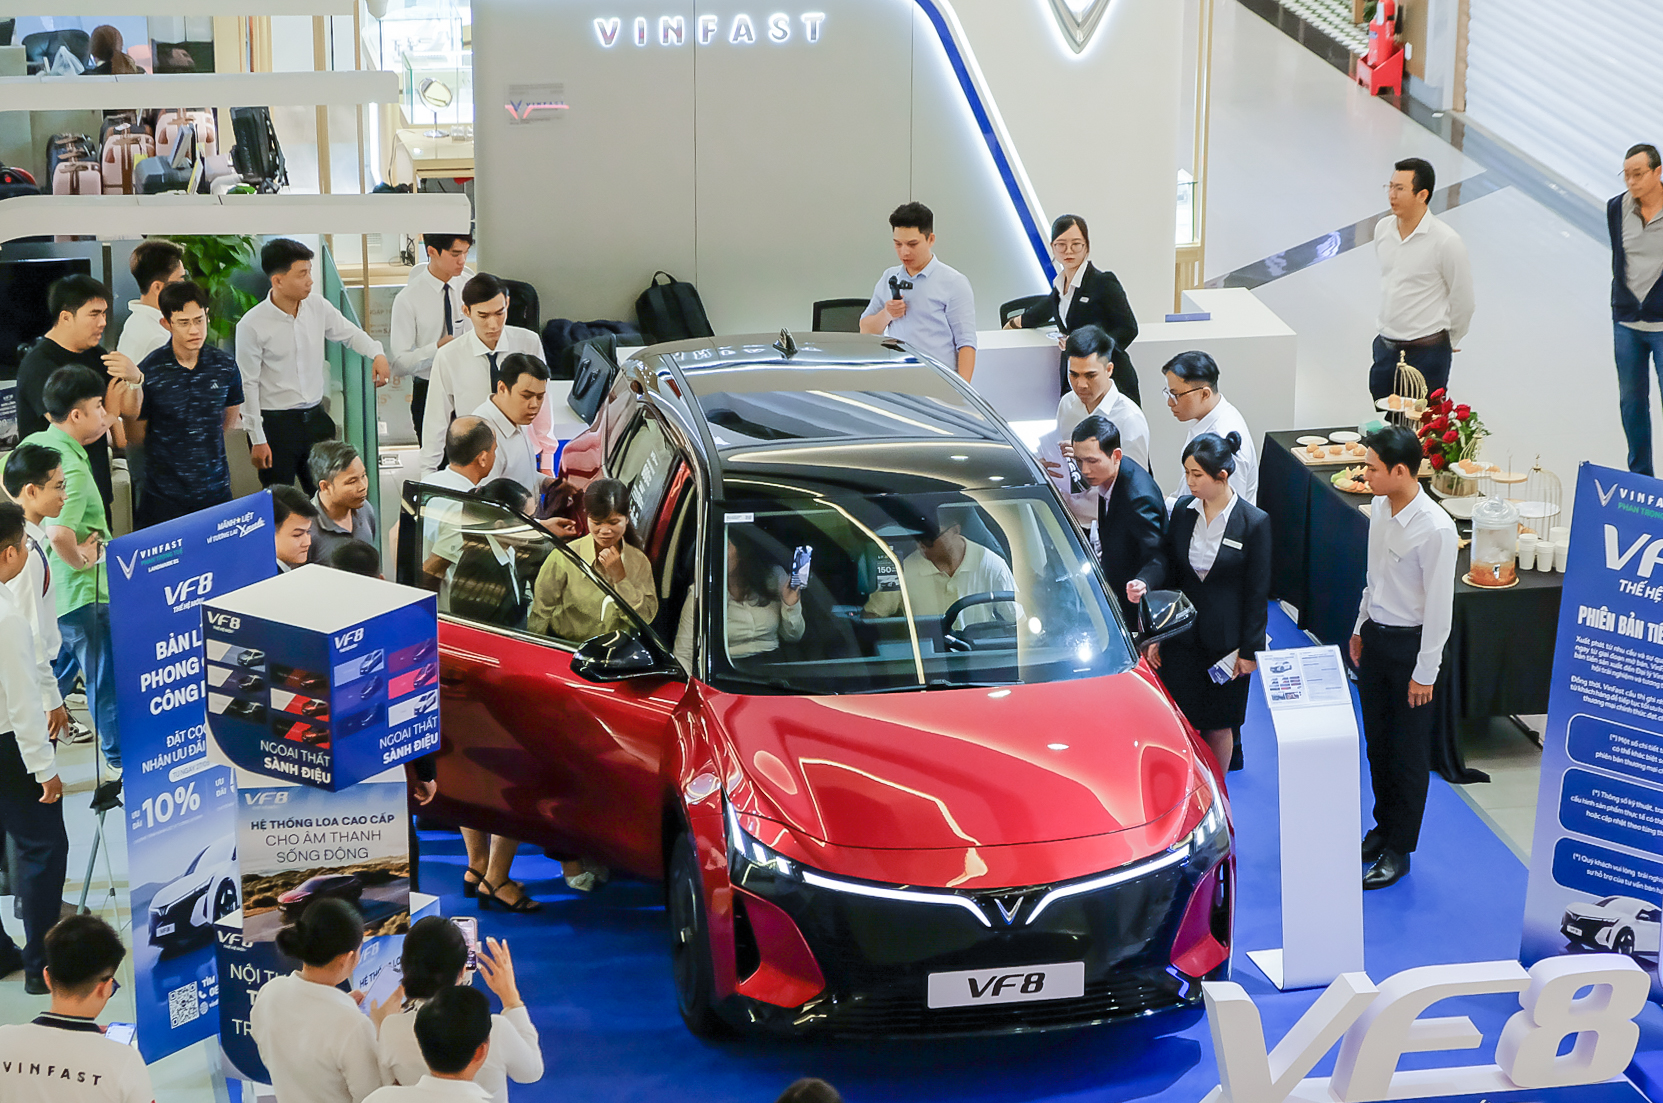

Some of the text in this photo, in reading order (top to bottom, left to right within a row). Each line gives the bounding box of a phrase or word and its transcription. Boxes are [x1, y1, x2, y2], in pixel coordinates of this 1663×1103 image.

[594, 13, 825, 47] VINFAST
[140, 538, 183, 559] VINFAST
[164, 571, 213, 606] VF8
[1619, 579, 1648, 597] THẾ
[207, 610, 241, 630] VF8
[1577, 605, 1616, 632] PHIÊN
[1617, 611, 1645, 640] BẢN
[156, 632, 191, 661] BẢN
[334, 628, 364, 649] VF8
[140, 656, 200, 693] PHONG
[149, 682, 199, 716] CÔNG
[166, 730, 186, 748] ĐẶT
[380, 716, 438, 749] NGOẠI THẤT
[260, 740, 330, 767] NGOẠI THẤT
[383, 731, 438, 764] SÀNH ĐIỆU
[142, 753, 171, 774] NHẬN
[264, 756, 331, 784] SÀNH ĐIỆU
[142, 781, 201, 829] 10%
[245, 791, 288, 806] VF8
[251, 812, 395, 831] HỆ THỐNG LOA CAO CẤP
[265, 830, 381, 847] CHO ÂM THANH
[276, 847, 369, 863] SỐNG ĐỘNG
[230, 962, 260, 985] NỘI
[968, 972, 1046, 998] VF8
[1201, 953, 1651, 1103] VF8
[3, 1061, 102, 1086] VINFAST
